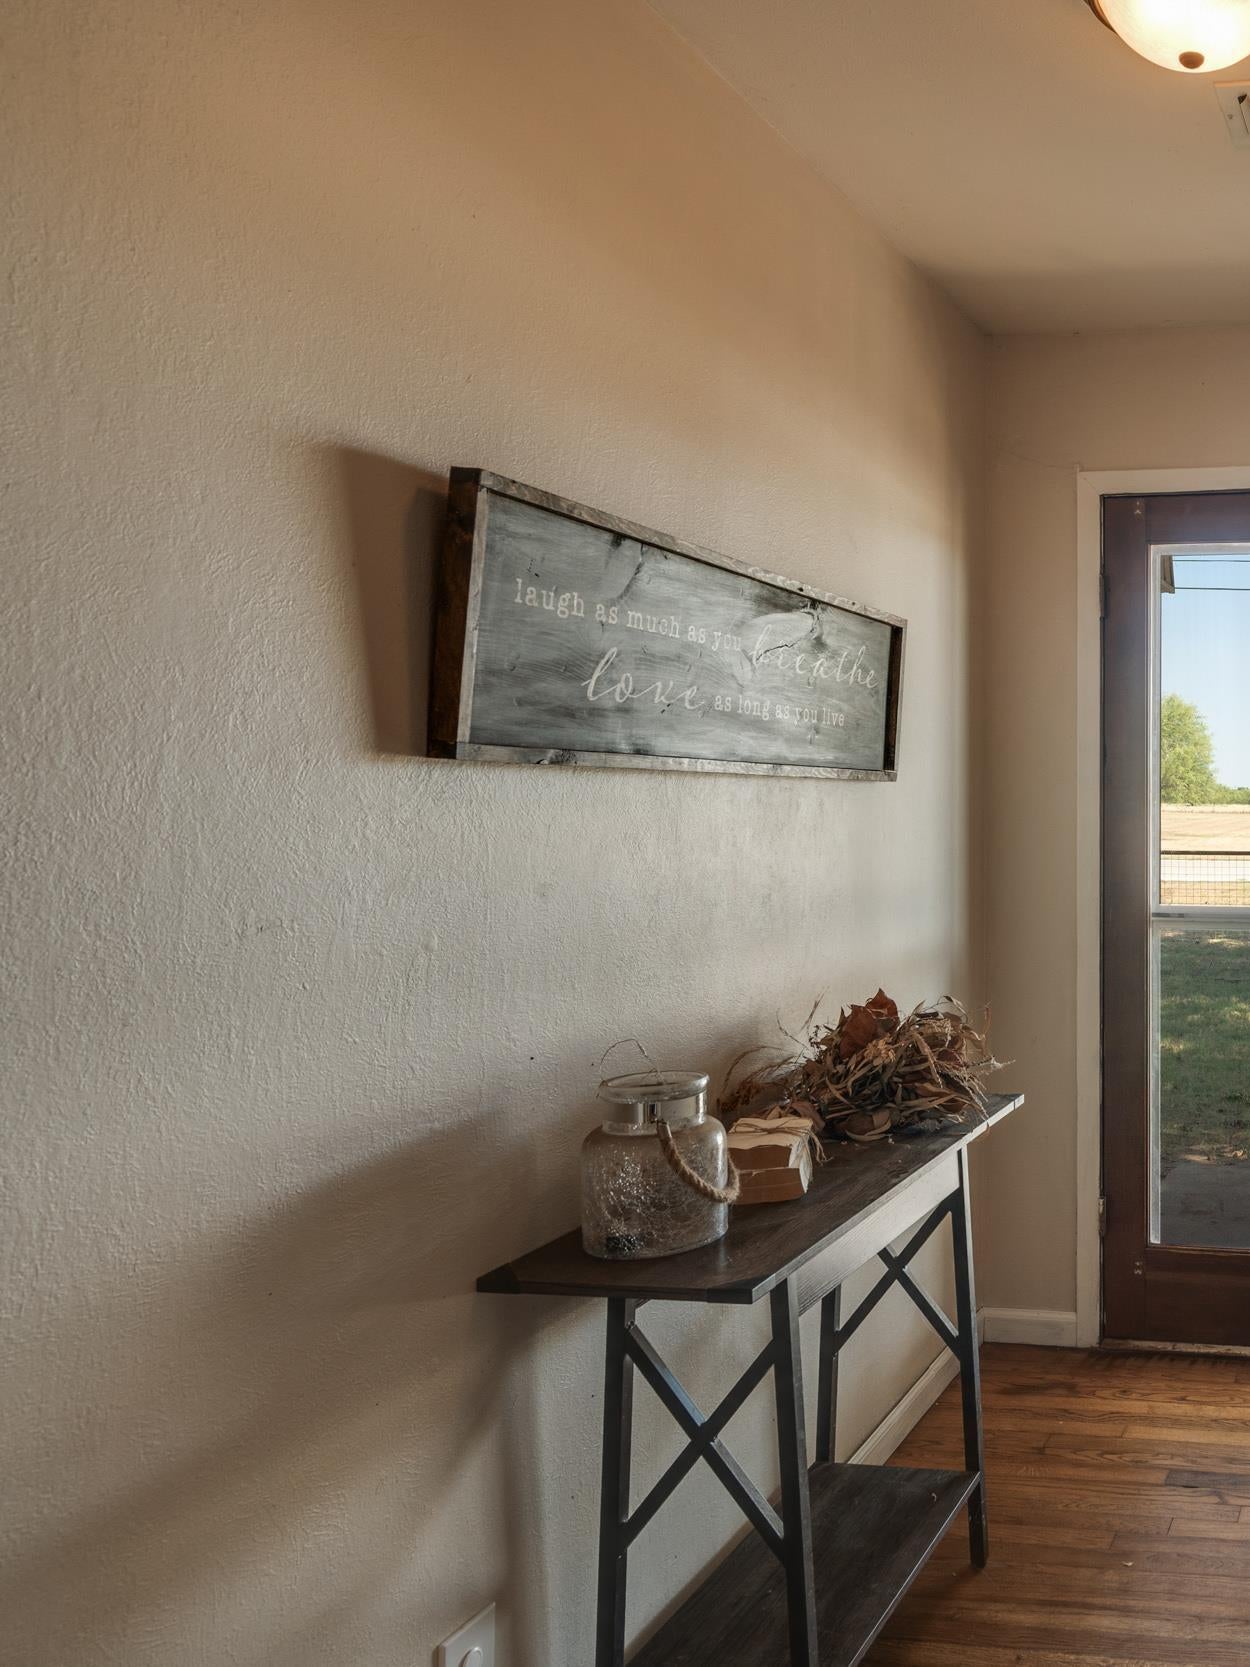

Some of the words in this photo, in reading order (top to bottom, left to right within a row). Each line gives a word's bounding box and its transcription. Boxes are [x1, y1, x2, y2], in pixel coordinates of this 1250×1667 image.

[513, 577, 585, 619] laugh
[594, 603, 619, 625] as
[626, 609, 680, 639] much
[687, 624, 707, 645] as
[712, 630, 742, 652] you
[749, 623, 880, 689] breathe
[580, 646, 705, 710] love
[714, 694, 733, 713] as
[738, 694, 771, 721] long
[774, 703, 790, 720] as
[793, 705, 818, 726] you
[822, 707, 845, 727] live
